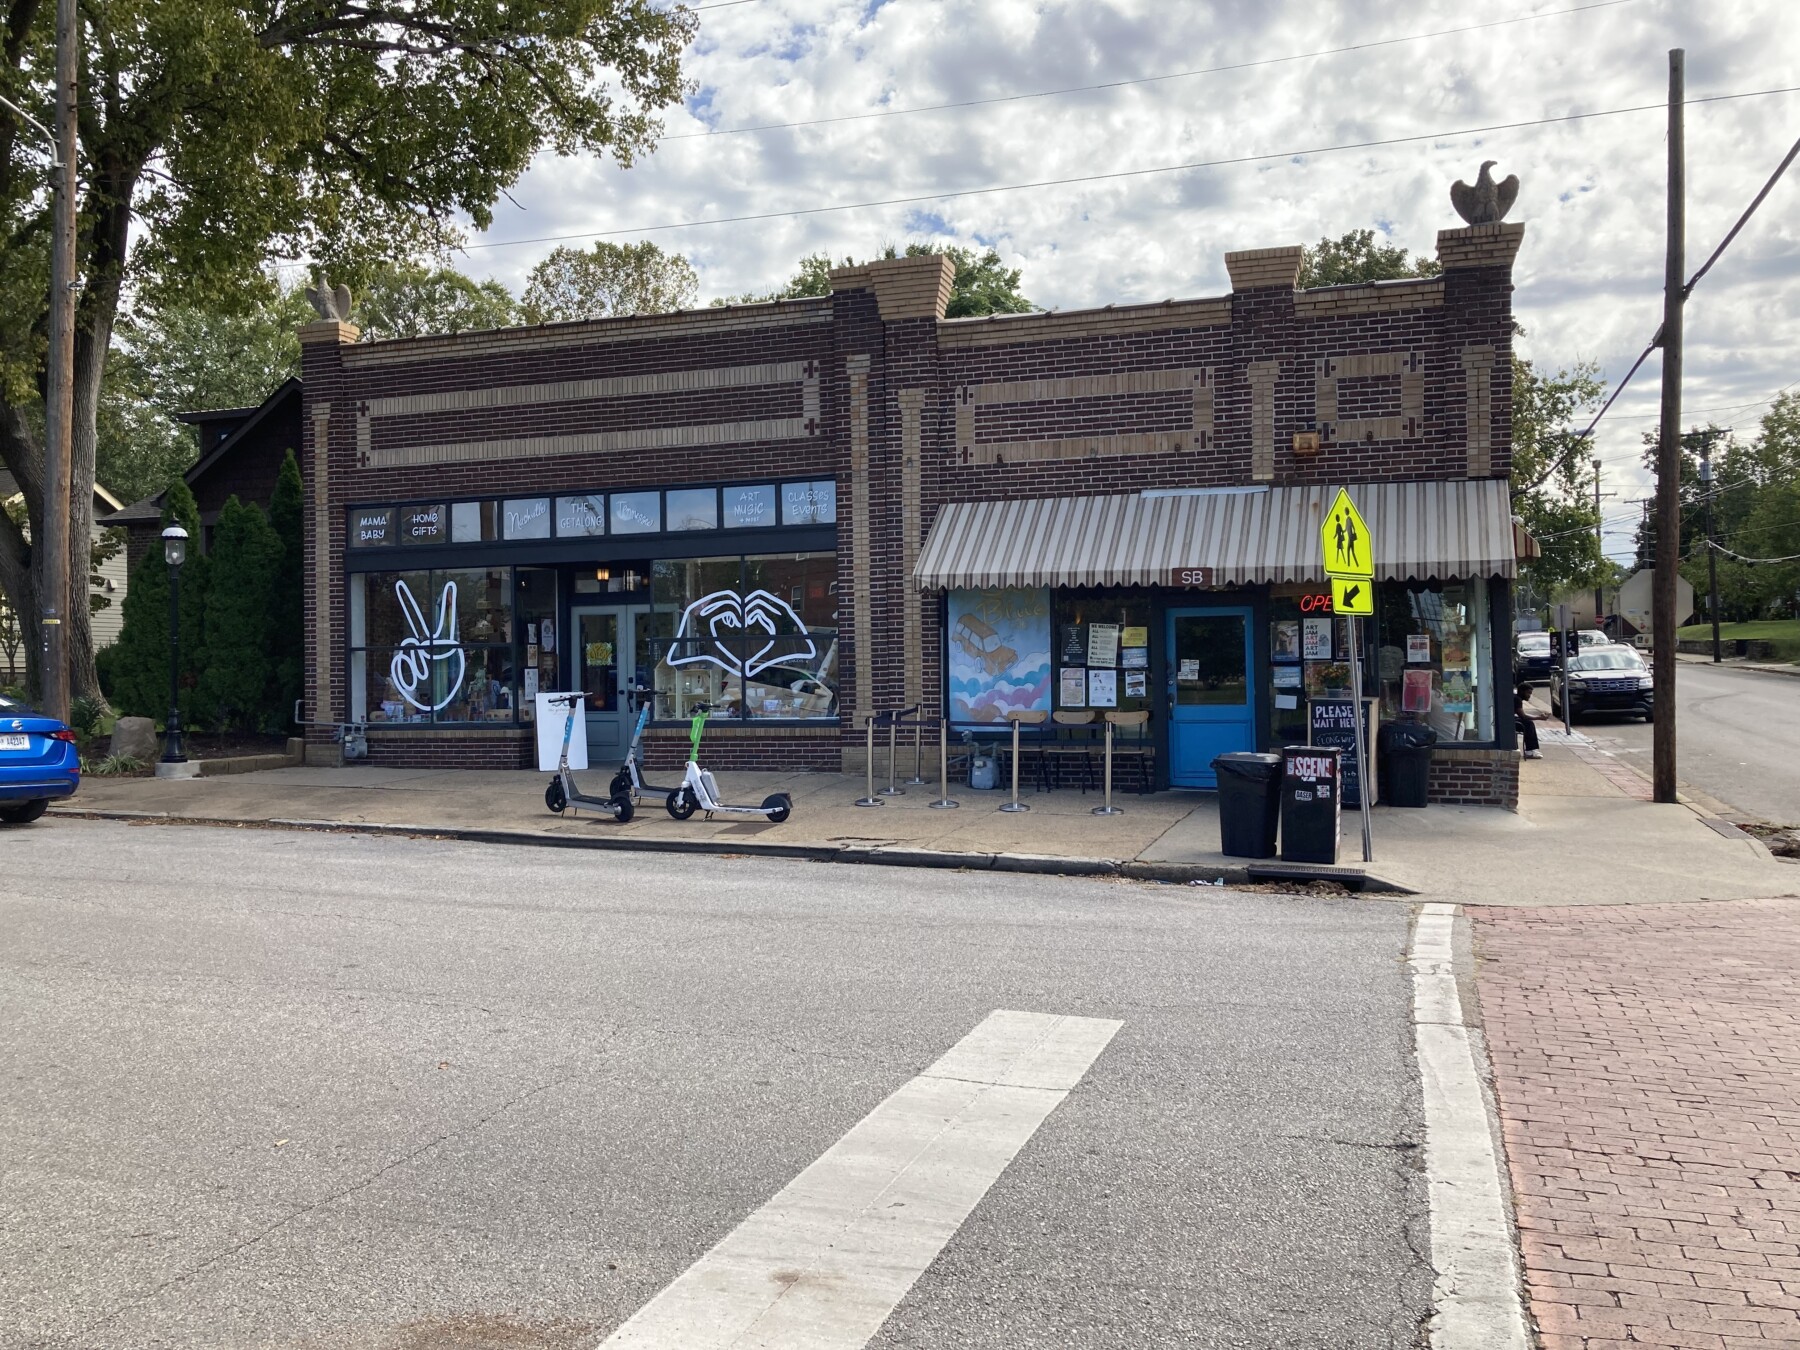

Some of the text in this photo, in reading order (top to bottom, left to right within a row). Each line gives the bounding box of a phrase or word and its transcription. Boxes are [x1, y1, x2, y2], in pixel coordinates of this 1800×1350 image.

[740, 491, 760, 501] ART
[571, 502, 589, 513] THE
[360, 516, 387, 527] MAMA
[560, 515, 602, 529] GETALONG
[361, 529, 385, 540] BABY
[1181, 570, 1203, 584] SB
[1300, 594, 1333, 612] OPE
[1315, 705, 1353, 719] PLEASE
[1313, 718, 1334, 729] WAIT
